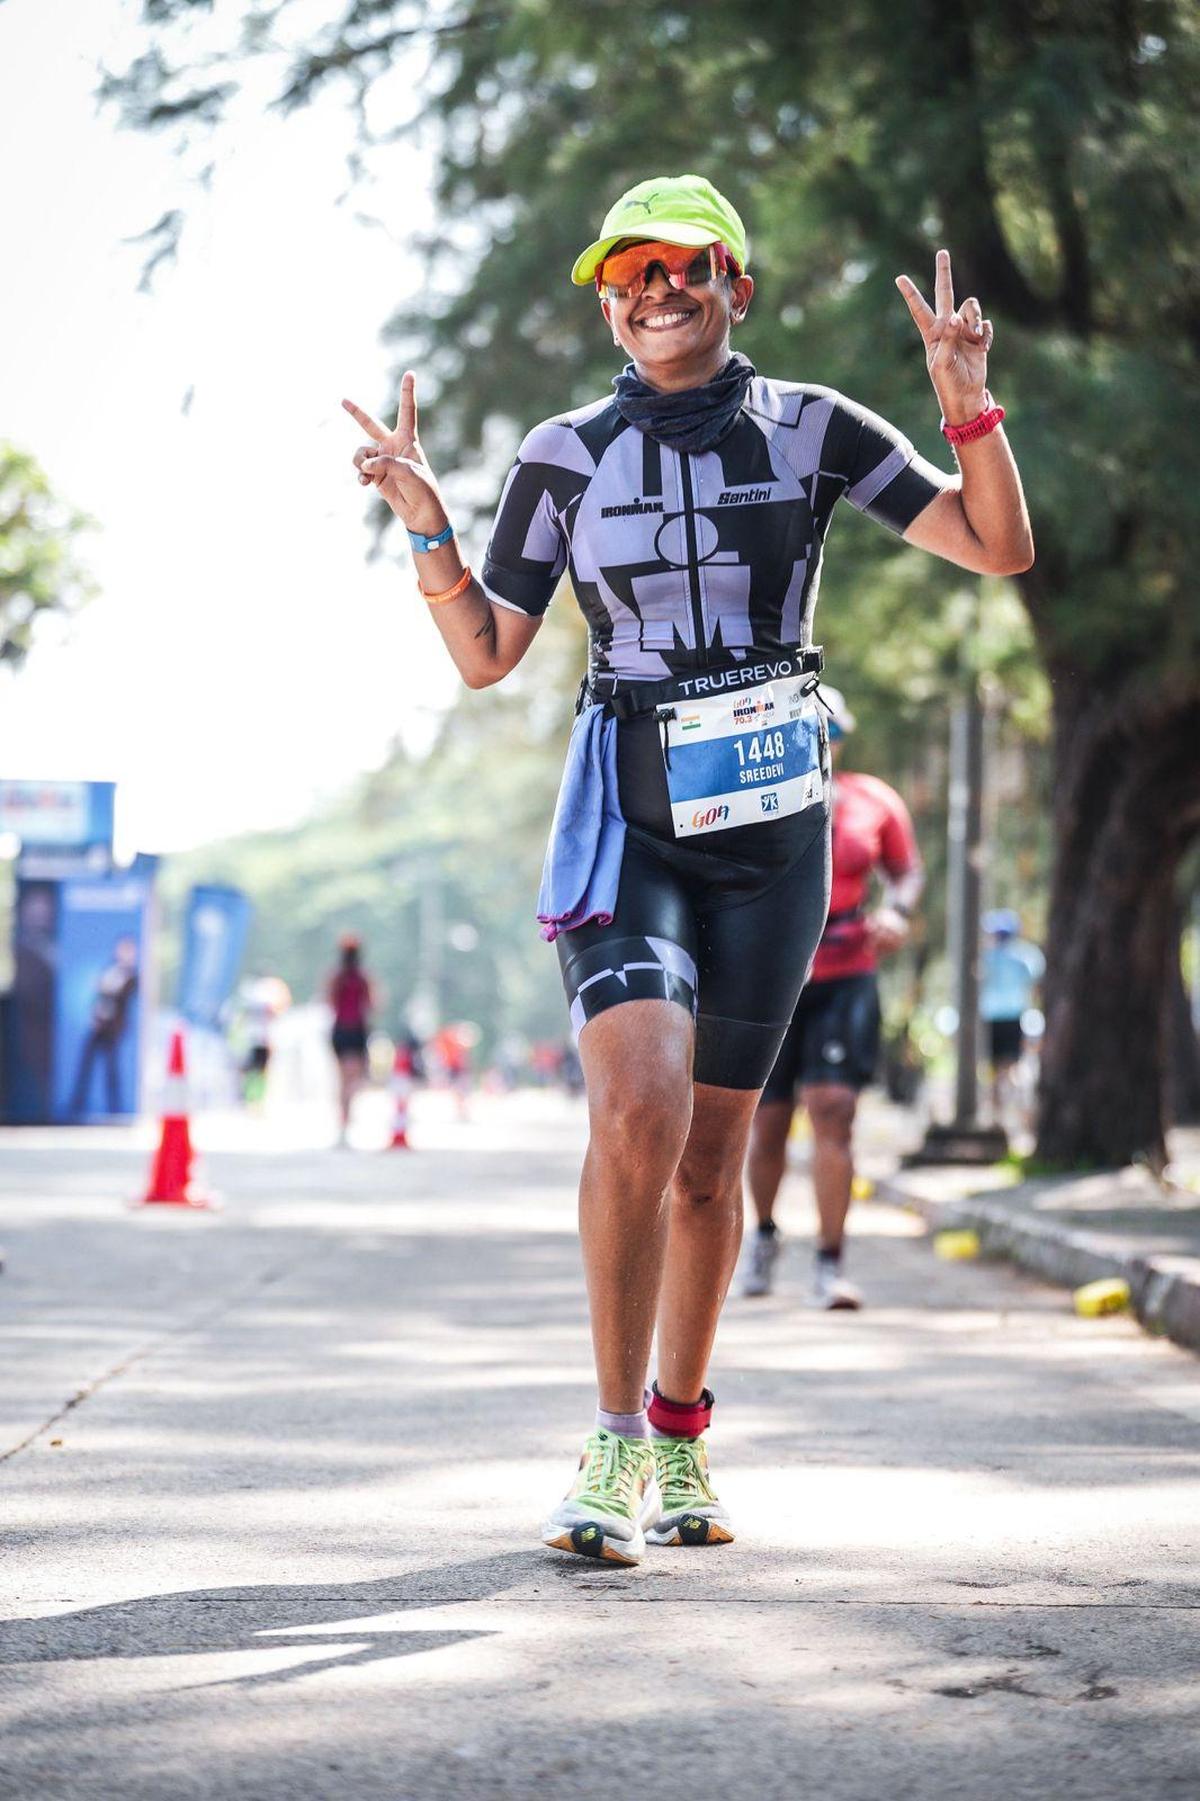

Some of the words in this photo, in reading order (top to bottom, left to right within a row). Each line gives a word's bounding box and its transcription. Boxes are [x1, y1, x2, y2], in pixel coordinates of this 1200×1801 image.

[717, 487, 771, 505] Santini
[601, 498, 665, 519] IRONMAN
[678, 660, 792, 697] TRUEREVO
[733, 701, 775, 717] IRONMAN
[733, 731, 785, 766] 1448
[739, 763, 784, 784] SREEDEVI
